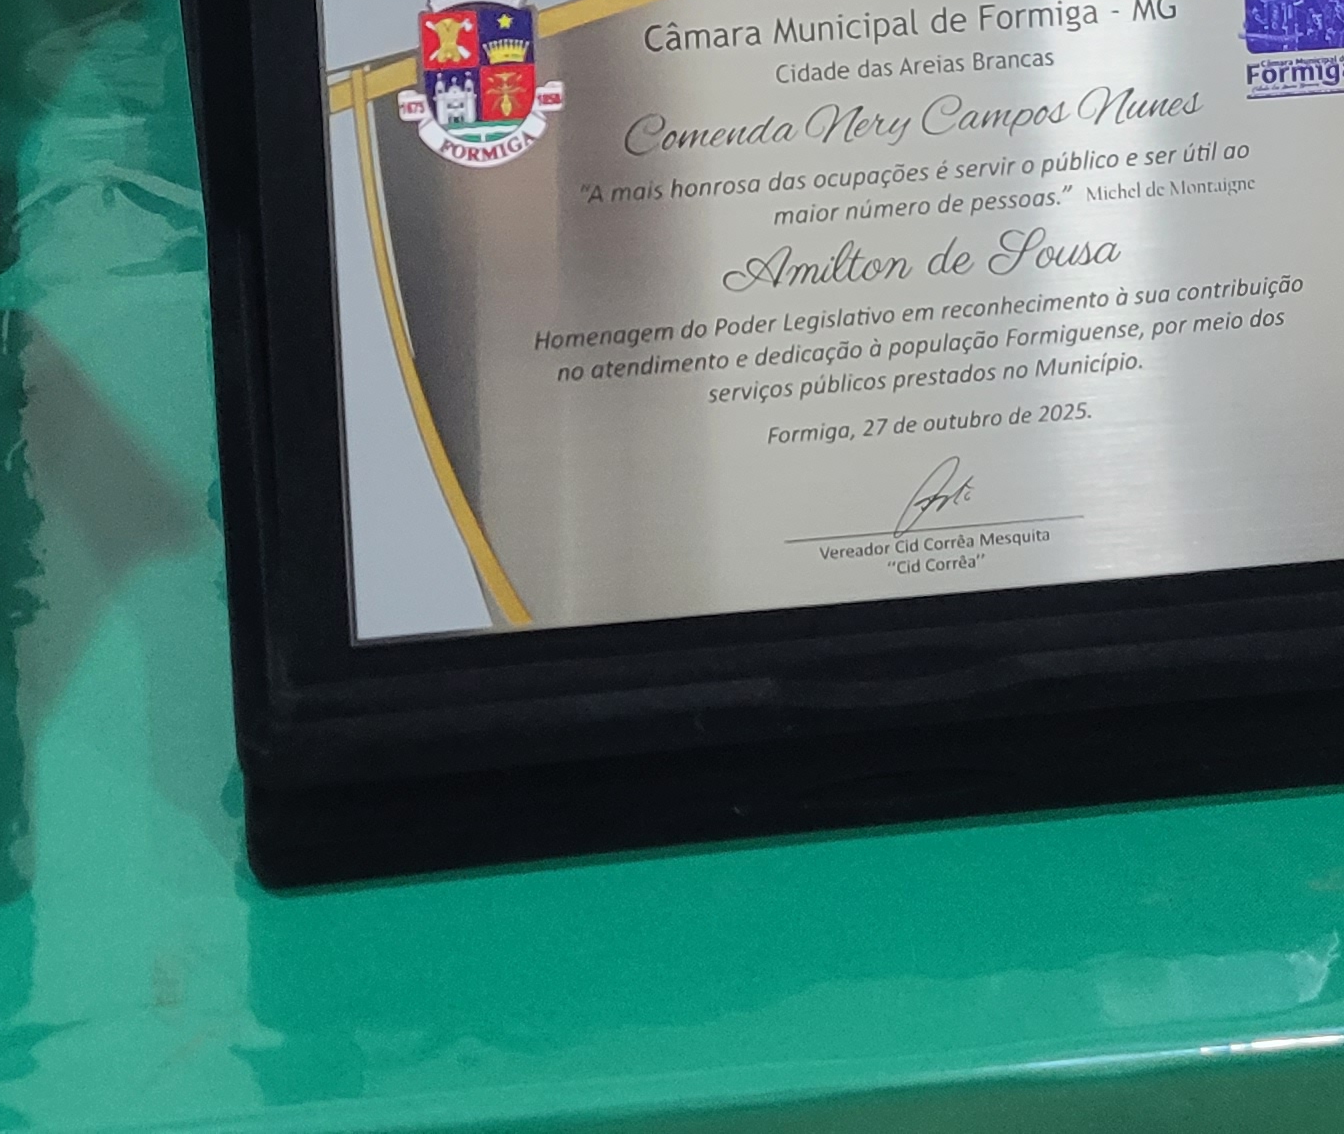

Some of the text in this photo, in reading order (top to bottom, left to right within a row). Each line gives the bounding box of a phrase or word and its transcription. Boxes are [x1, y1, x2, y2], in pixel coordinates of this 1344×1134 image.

[439, 131, 537, 162] FORMIGA
[610, 185, 664, 202] mais
[670, 178, 761, 199] honrosa
[767, 171, 807, 192] das
[813, 163, 929, 191] ocupações
[936, 161, 948, 180] é
[954, 156, 1017, 180] servir
[1022, 160, 1034, 174] o
[1040, 149, 1120, 178] público
[1126, 152, 1138, 166] e
[1144, 149, 1177, 166] ser
[1182, 141, 1218, 163] útil
[1223, 144, 1250, 160] ao
[773, 203, 840, 226] maior
[845, 199, 932, 221] número
[937, 193, 965, 214] de
[1086, 181, 1142, 201] Michel
[1145, 180, 1165, 198] de
[1169, 178, 1256, 198] Montaigne
[722, 226, 1122, 293] Amilton de Sousa
[819, 530, 1051, 560] Vereador Cid Corrêa Mesquita
